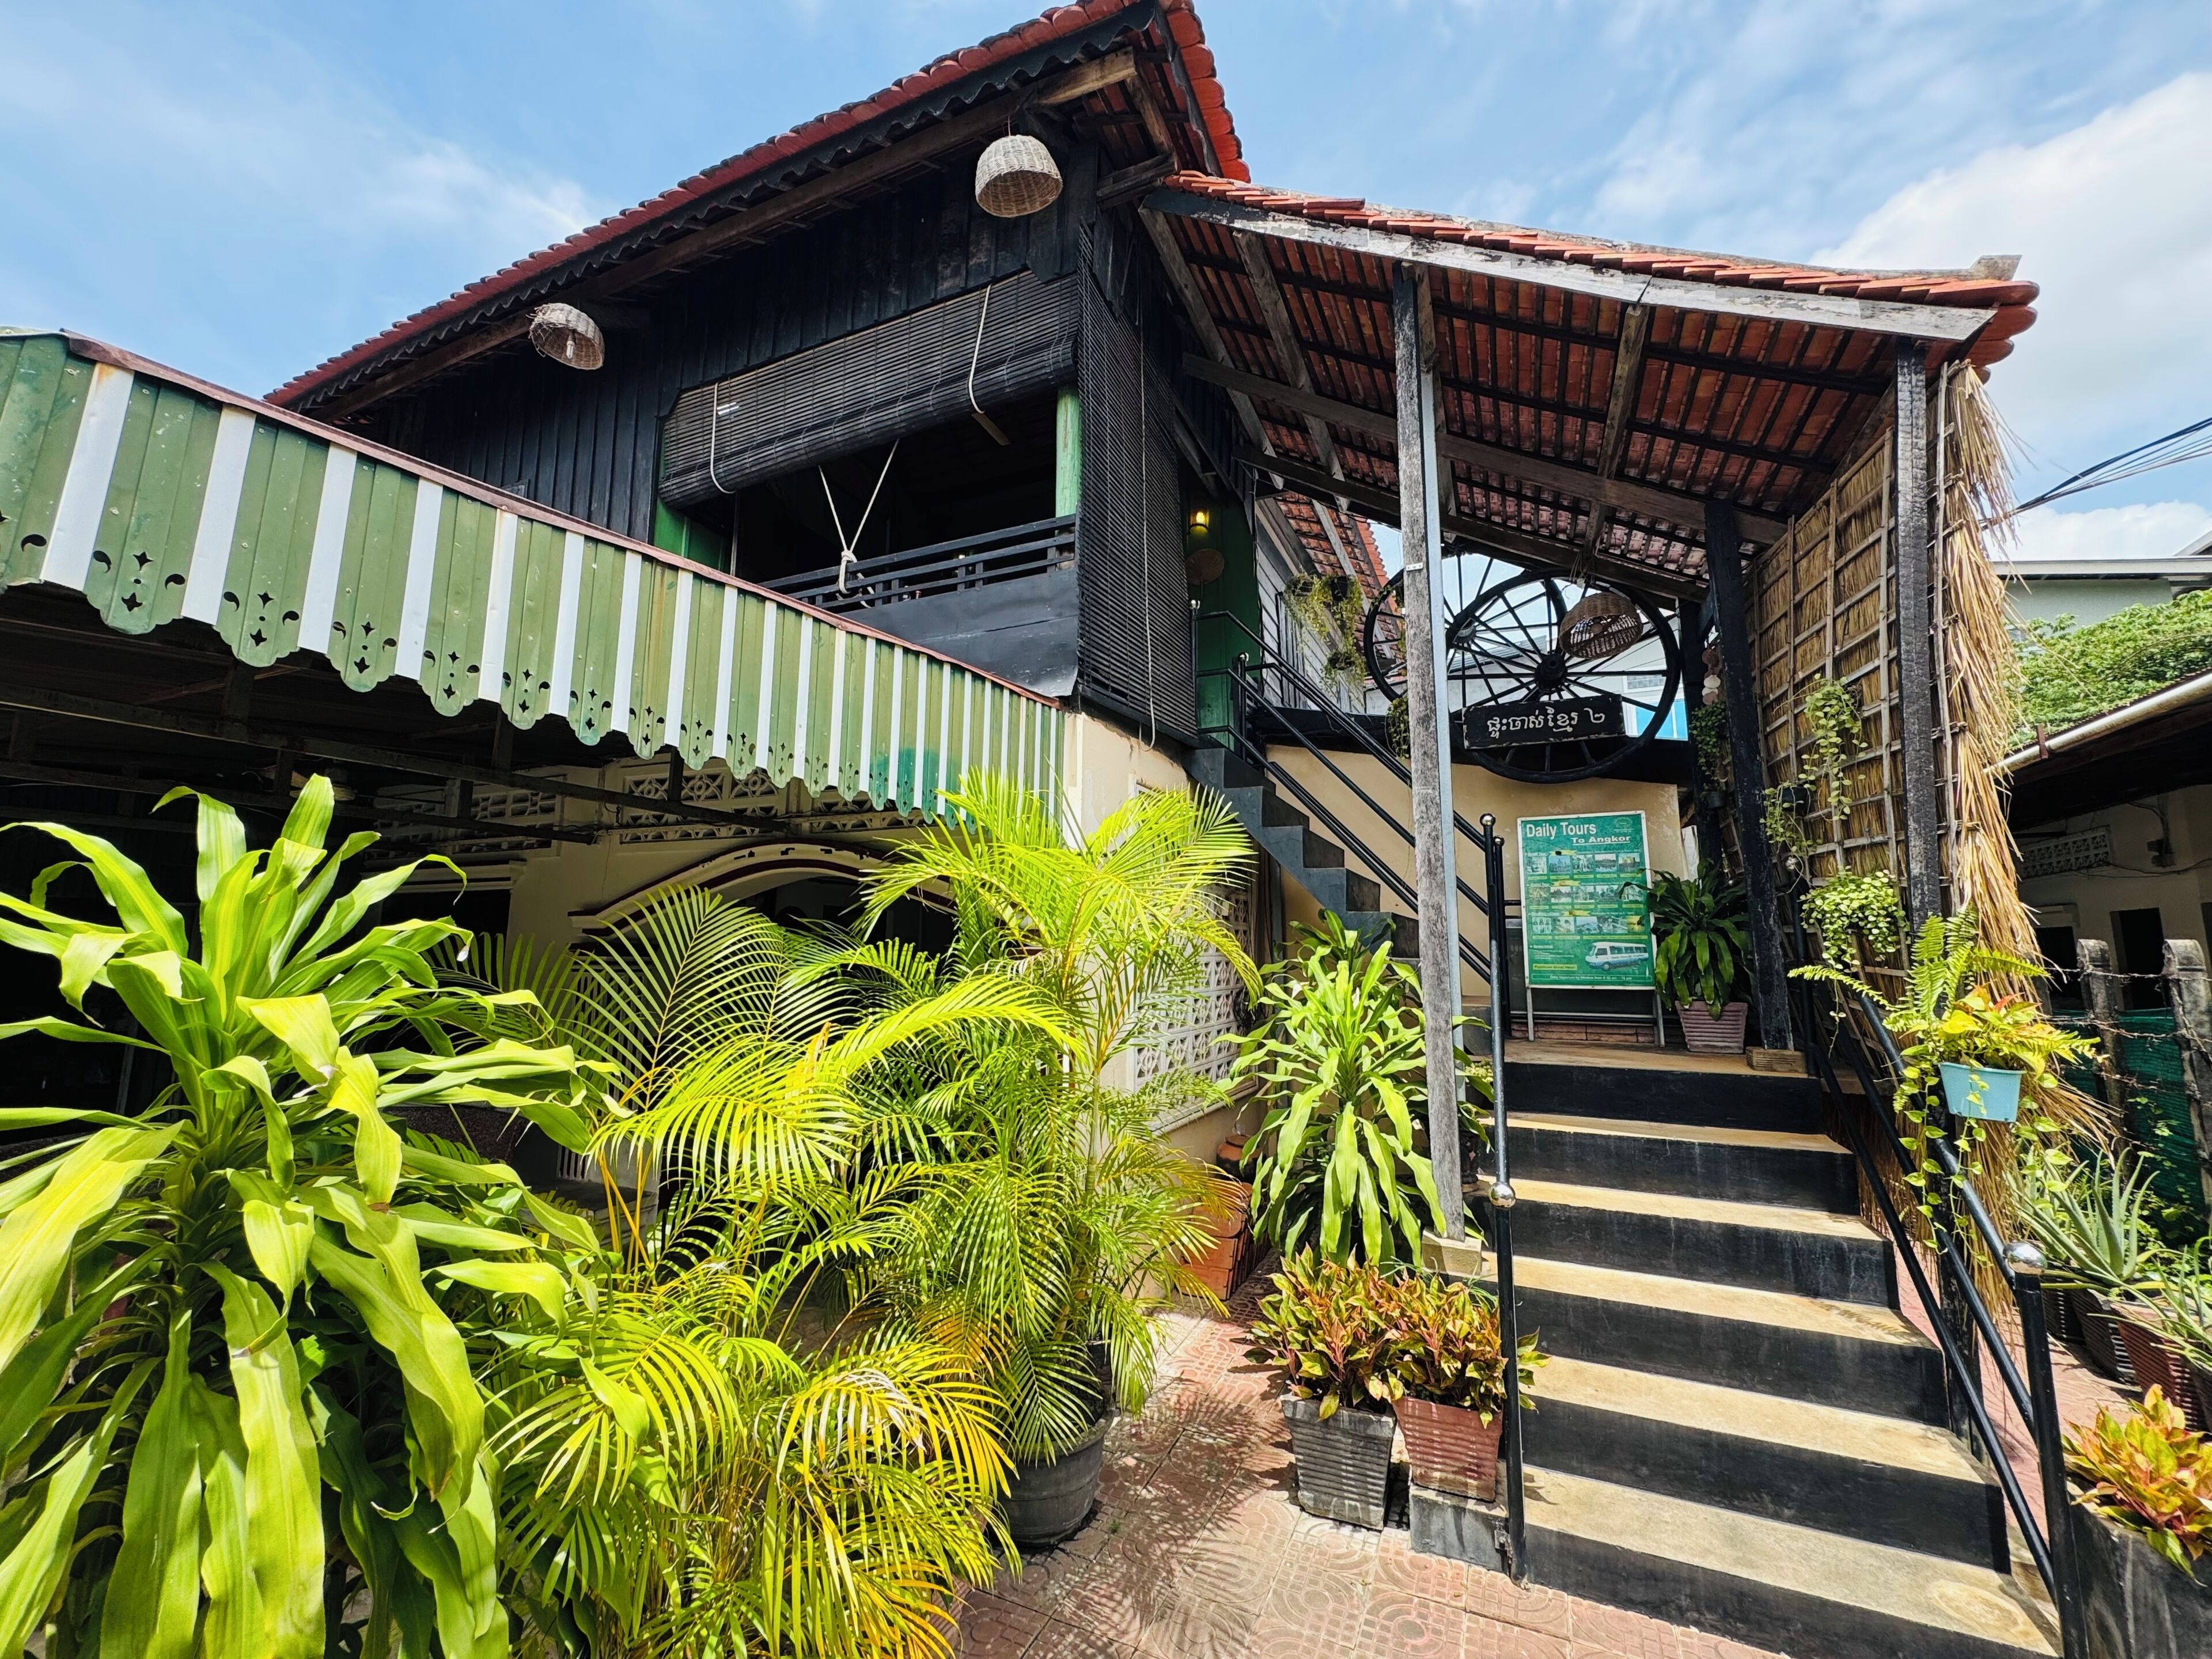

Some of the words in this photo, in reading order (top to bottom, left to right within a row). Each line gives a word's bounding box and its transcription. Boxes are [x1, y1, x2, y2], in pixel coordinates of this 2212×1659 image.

[1583, 707, 1605, 723] ២
[1526, 823, 1557, 840] Daily
[1560, 822, 1597, 835] Tours
[1588, 835, 1631, 843] Angkor
